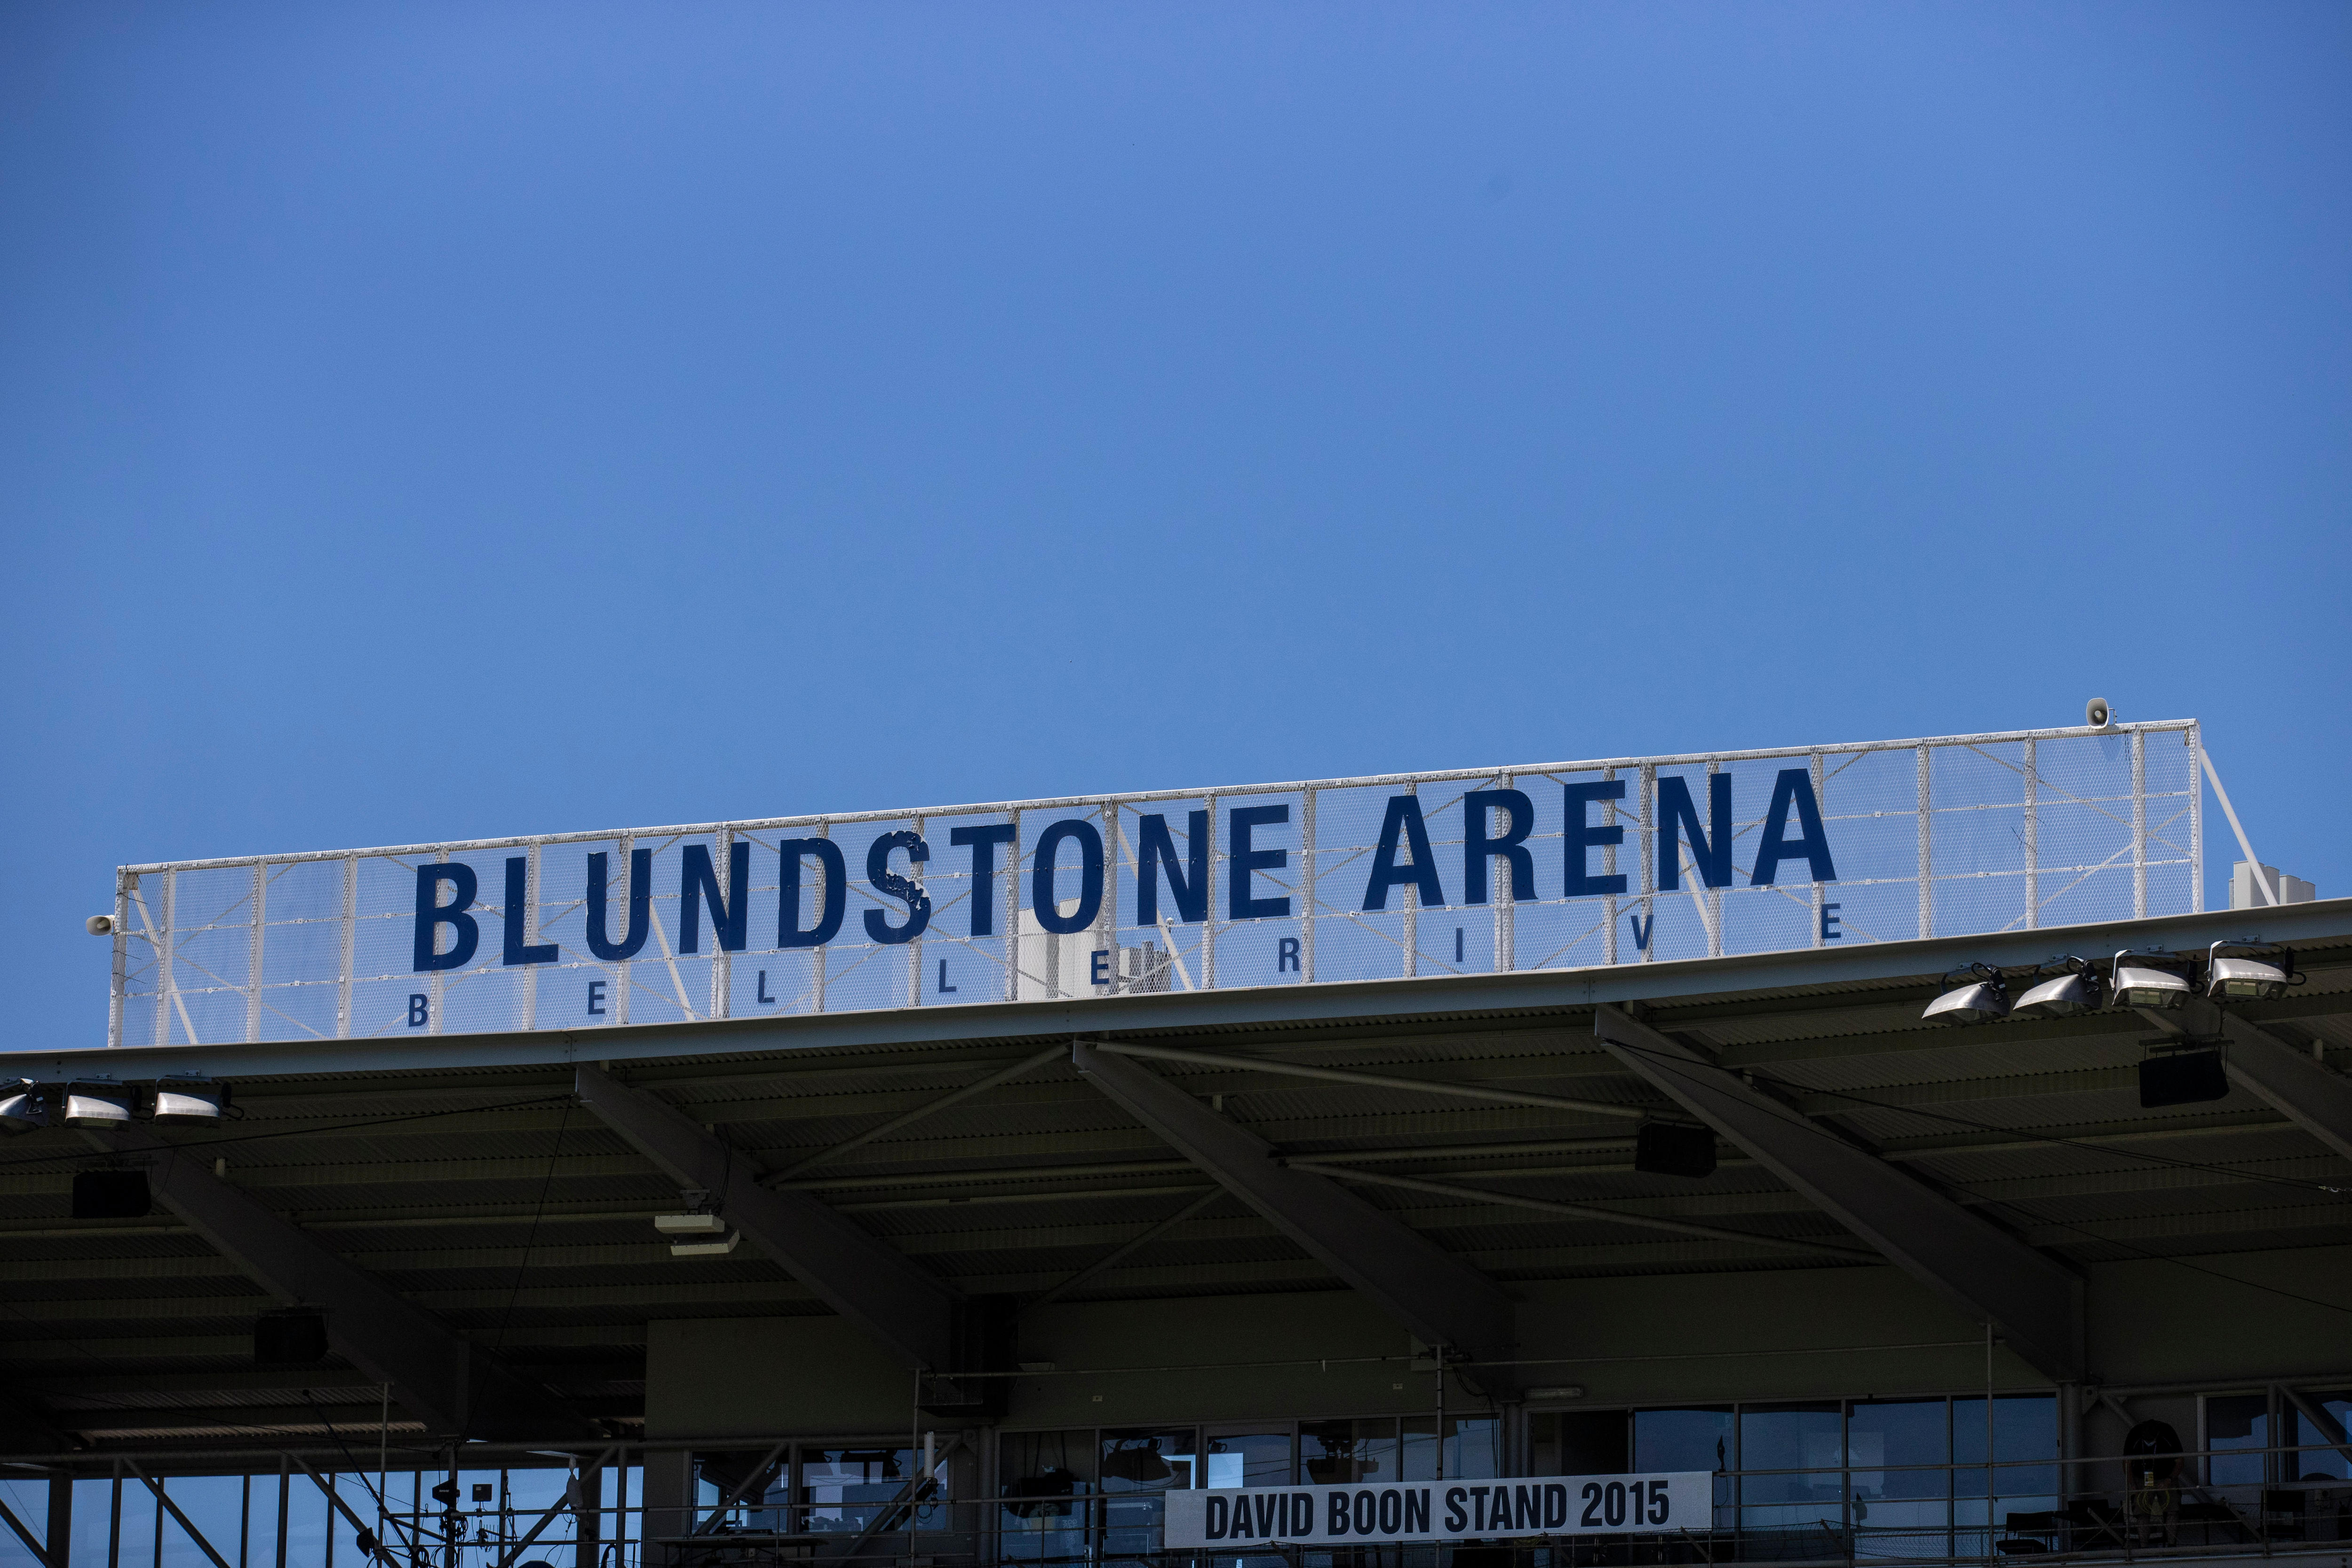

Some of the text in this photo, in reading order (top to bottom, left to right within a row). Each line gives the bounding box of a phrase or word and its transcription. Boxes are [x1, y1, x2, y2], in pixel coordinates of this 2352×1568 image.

[413, 768, 1837, 972] BLUNDSTONE ARENA
[1205, 1480, 1669, 1540] DAVID BOON STAND 2015
